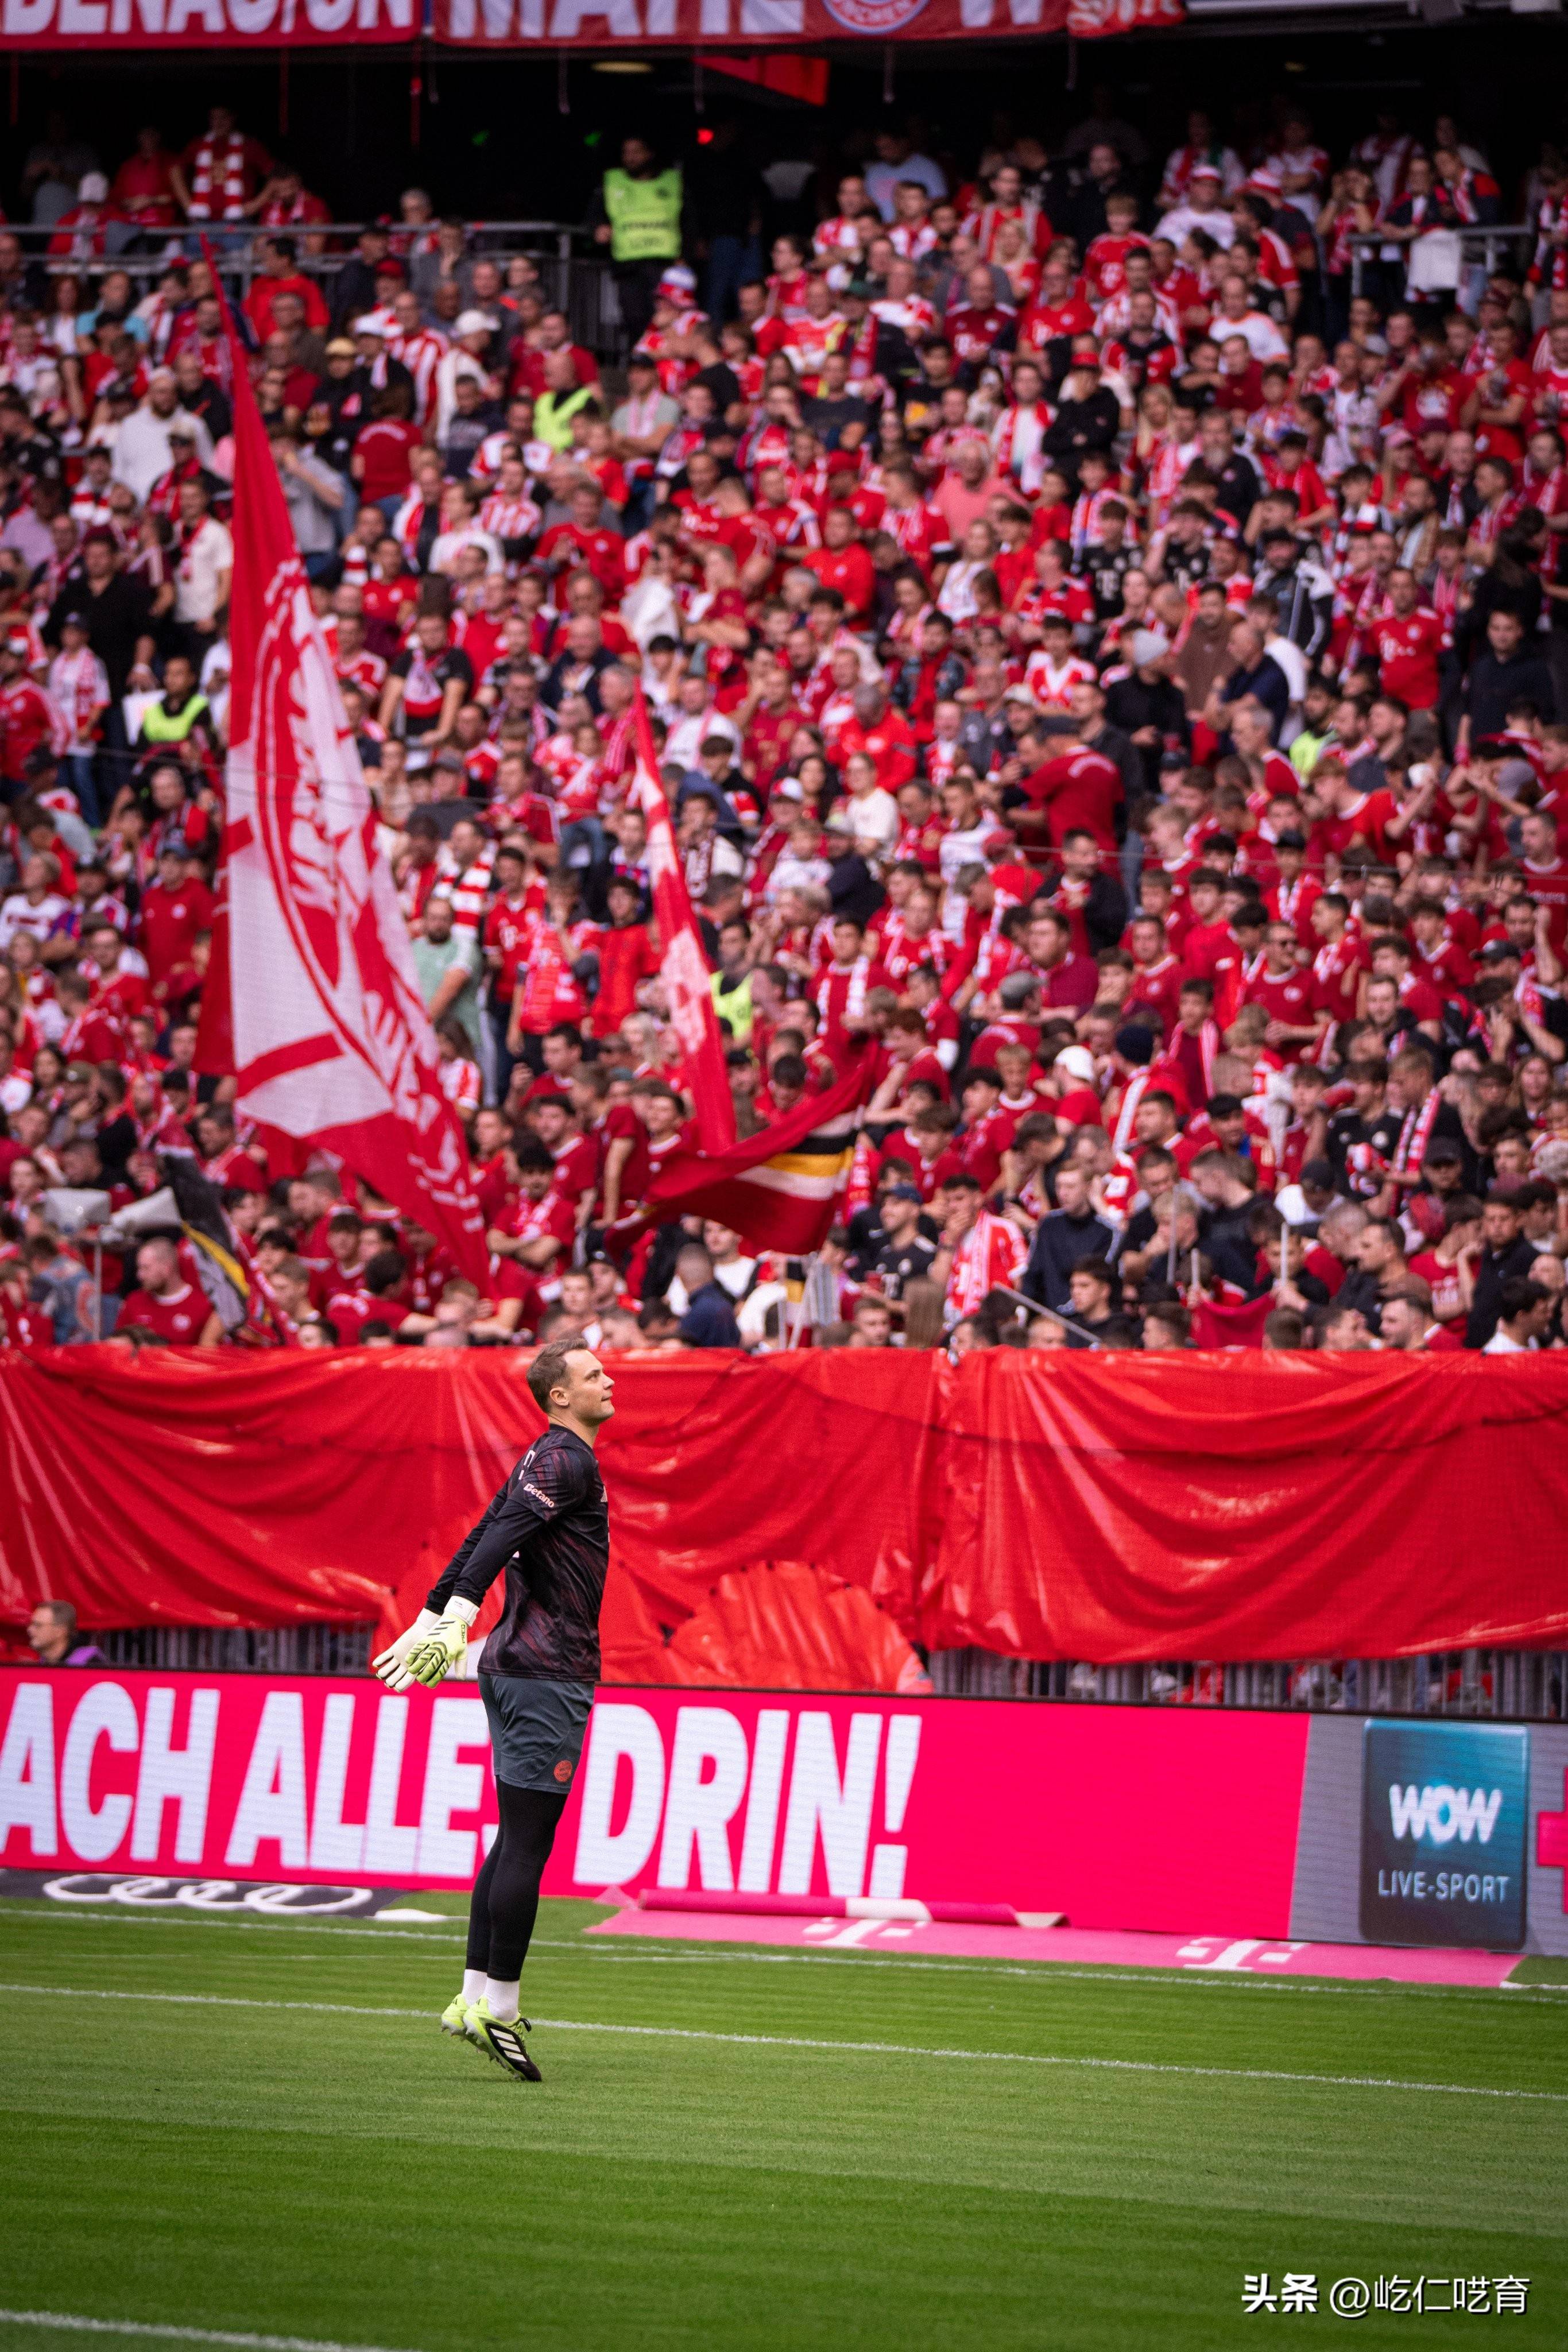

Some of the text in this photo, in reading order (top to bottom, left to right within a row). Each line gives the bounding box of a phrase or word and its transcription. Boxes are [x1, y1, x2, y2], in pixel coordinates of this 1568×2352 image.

[523, 1483, 555, 1508] Betano
[0, 1682, 922, 1898] ACH ALLE DRIN!
[1389, 1784, 1503, 1843] WOW
